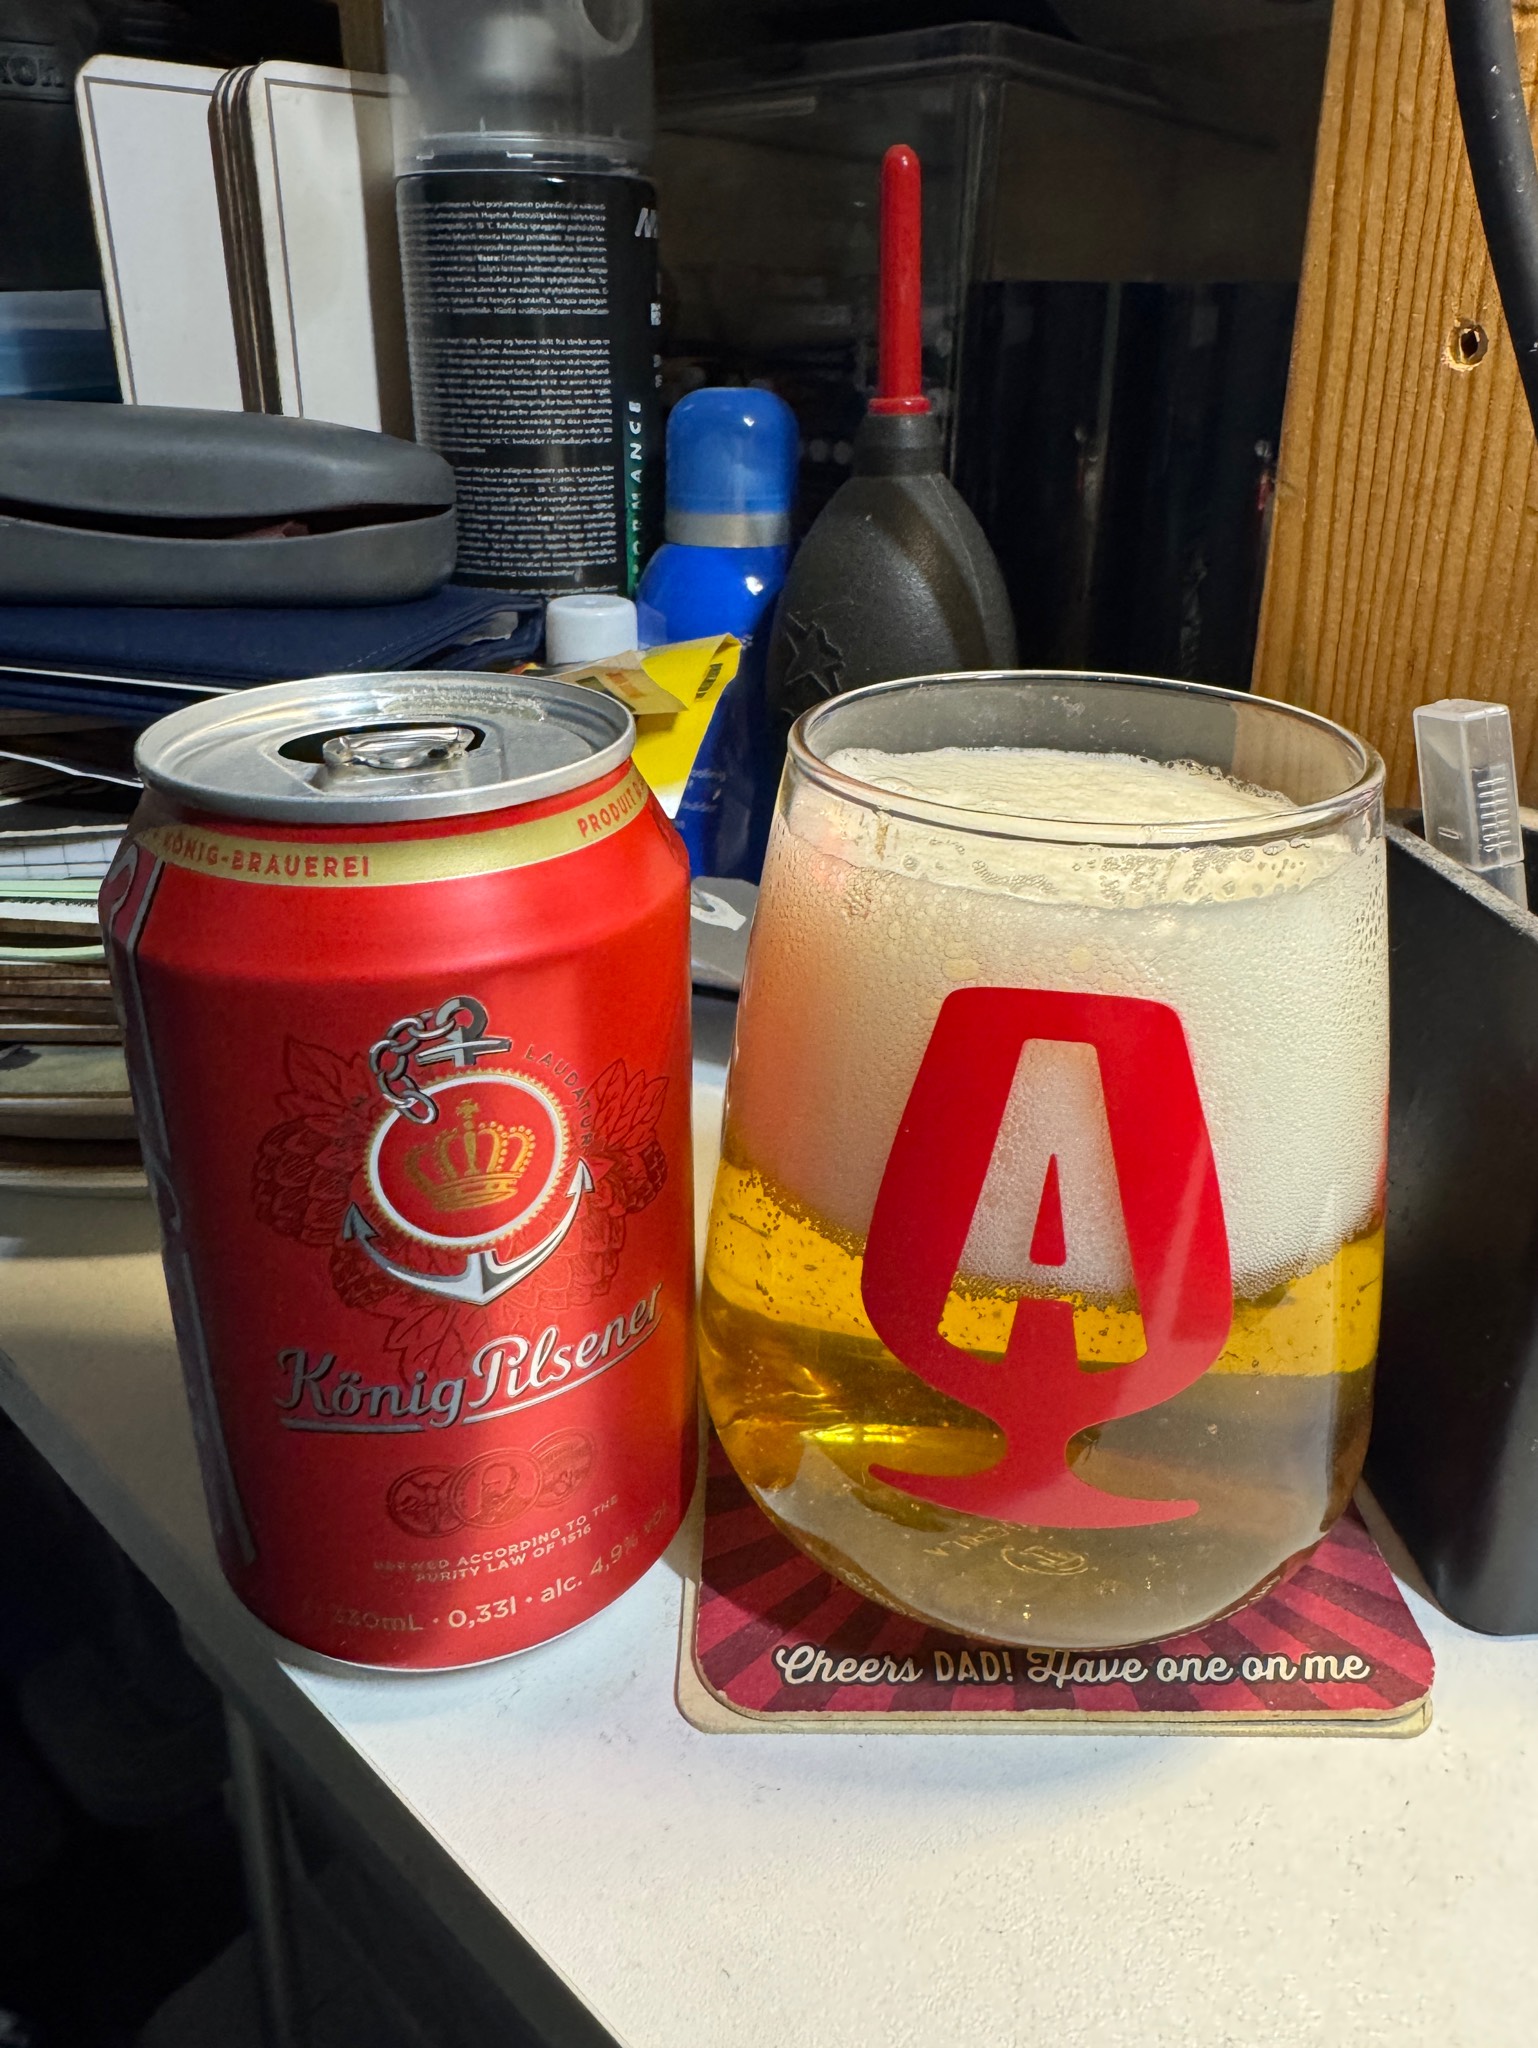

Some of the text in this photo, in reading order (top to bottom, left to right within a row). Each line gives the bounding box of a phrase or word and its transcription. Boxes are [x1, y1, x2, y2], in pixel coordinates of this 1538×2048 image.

[577, 788, 637, 838] PRODUIT
[524, 1044, 594, 1146] LAUDATUR
[276, 1282, 663, 1429] König Pilsener
[416, 1524, 591, 1583] PURITY LAW OF 1516
[457, 1527, 561, 1567] ACCORDING
[566, 1515, 587, 1531] TO
[592, 1494, 618, 1517] THE
[540, 1575, 583, 1602] alc.
[775, 1645, 1371, 1689] Cheers DAD! Have one on me
